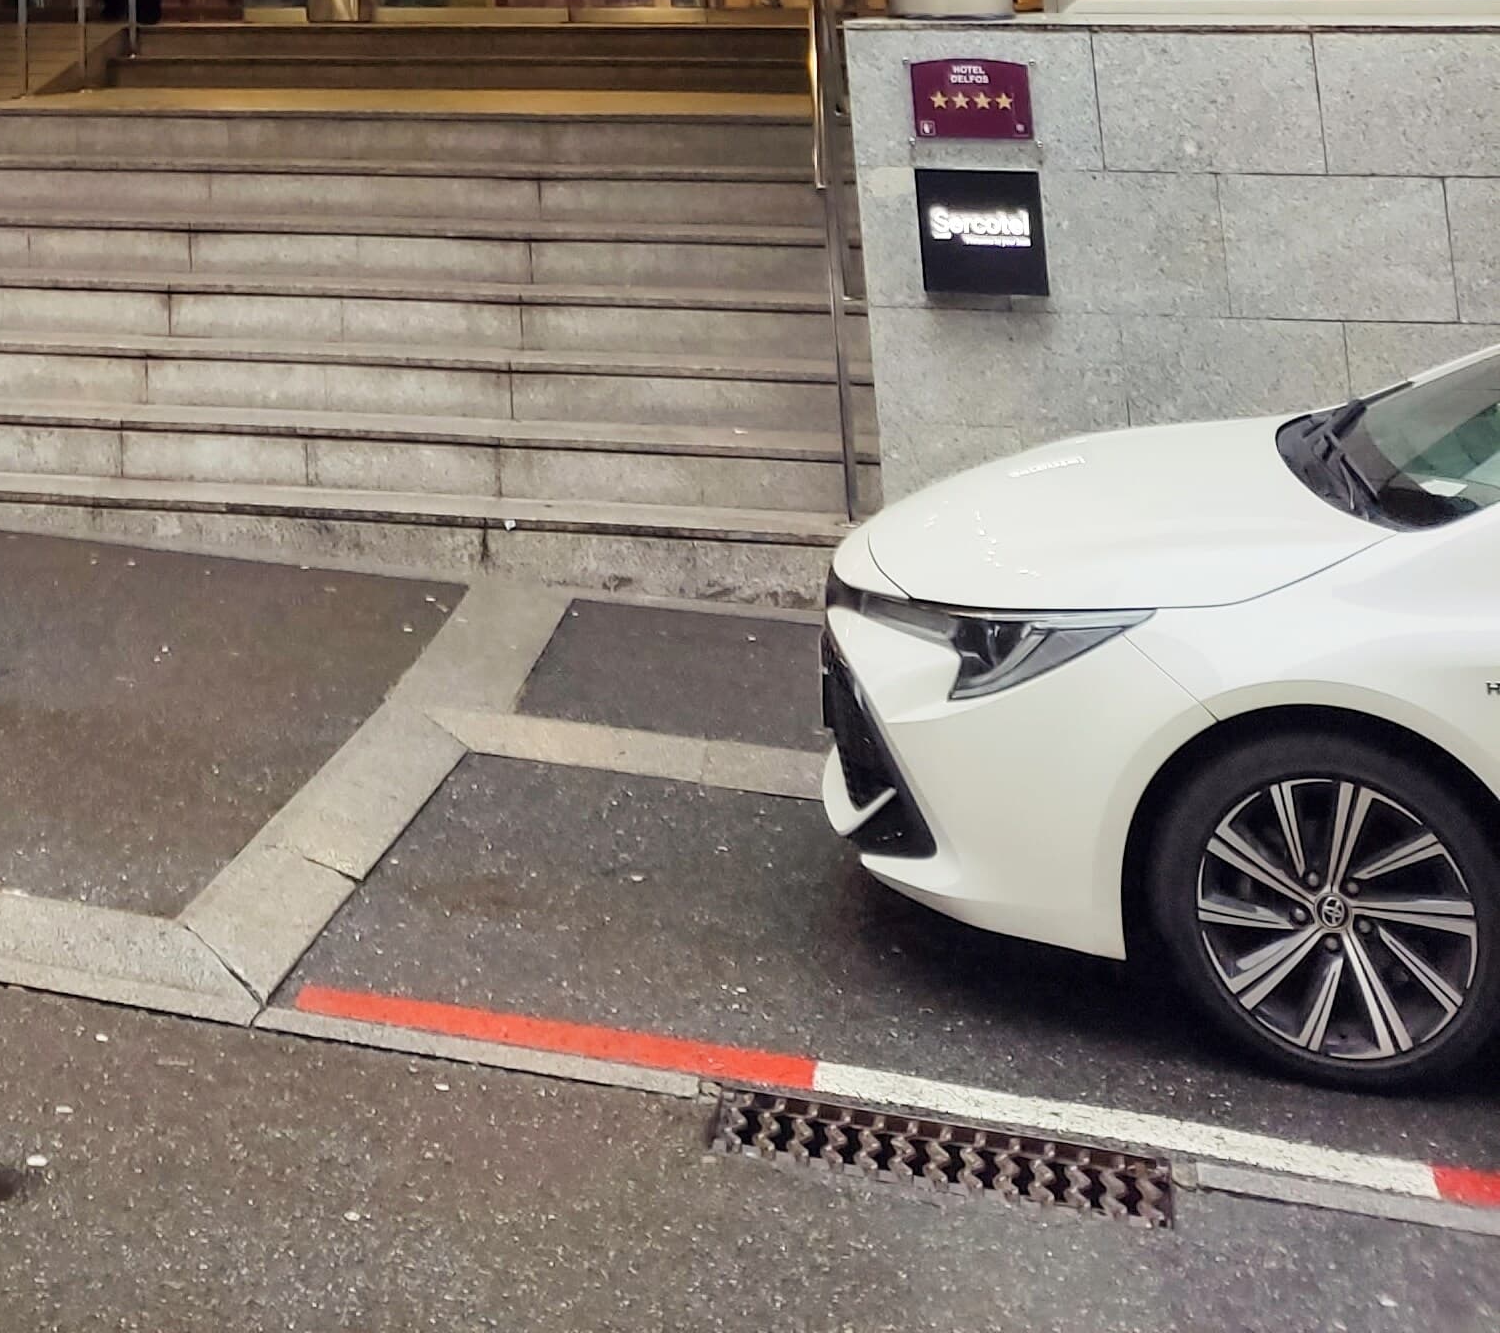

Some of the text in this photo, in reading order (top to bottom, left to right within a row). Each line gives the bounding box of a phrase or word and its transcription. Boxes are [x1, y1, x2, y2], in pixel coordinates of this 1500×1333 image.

[952, 65, 986, 74] HOTEL
[950, 74, 989, 84] DELFOS
[930, 206, 1030, 236] Sercotel
